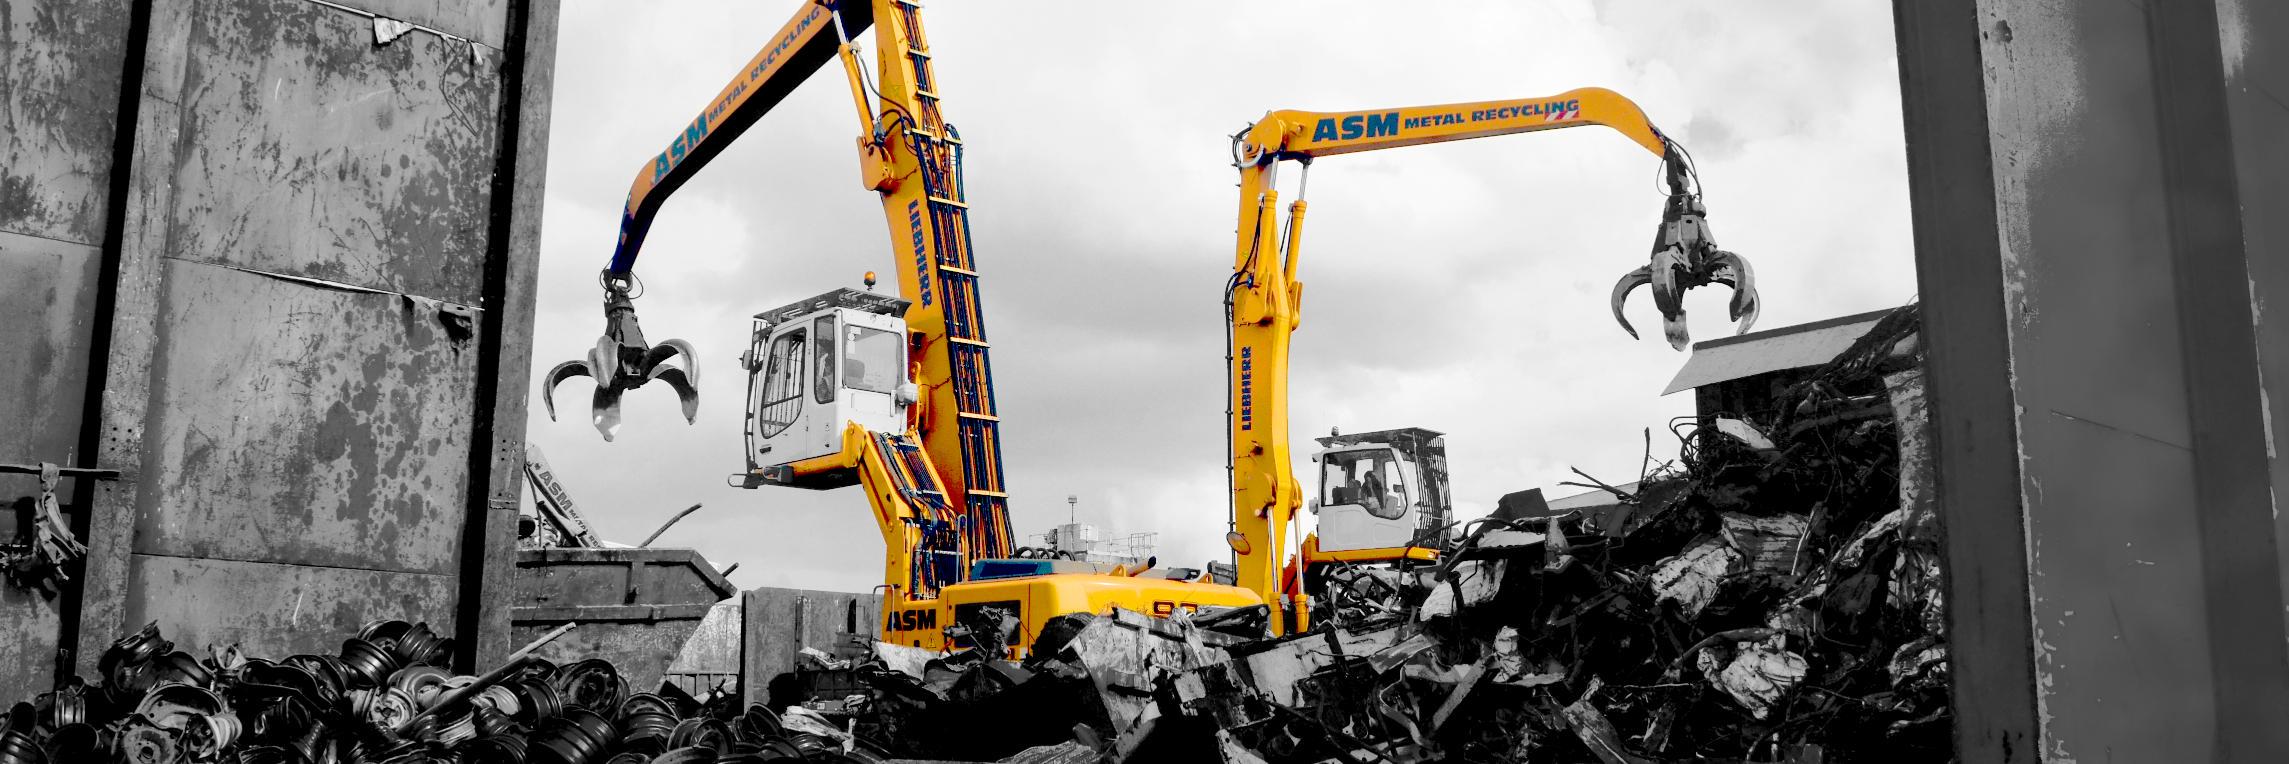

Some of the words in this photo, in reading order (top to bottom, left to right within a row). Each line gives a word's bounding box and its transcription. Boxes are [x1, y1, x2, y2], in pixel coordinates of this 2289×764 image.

[653, 111, 708, 185] ASM
[708, 81, 748, 123] METAL
[751, 5, 820, 82] RECYCLING
[1312, 112, 1399, 142] ASM
[1404, 110, 1465, 130] METAL
[1471, 100, 1580, 122] RECYCLING
[908, 199, 933, 310] LIEBHERR
[1241, 346, 1252, 431] LIEBHERR
[539, 471, 573, 511] ASM
[886, 609, 937, 632] ASM
